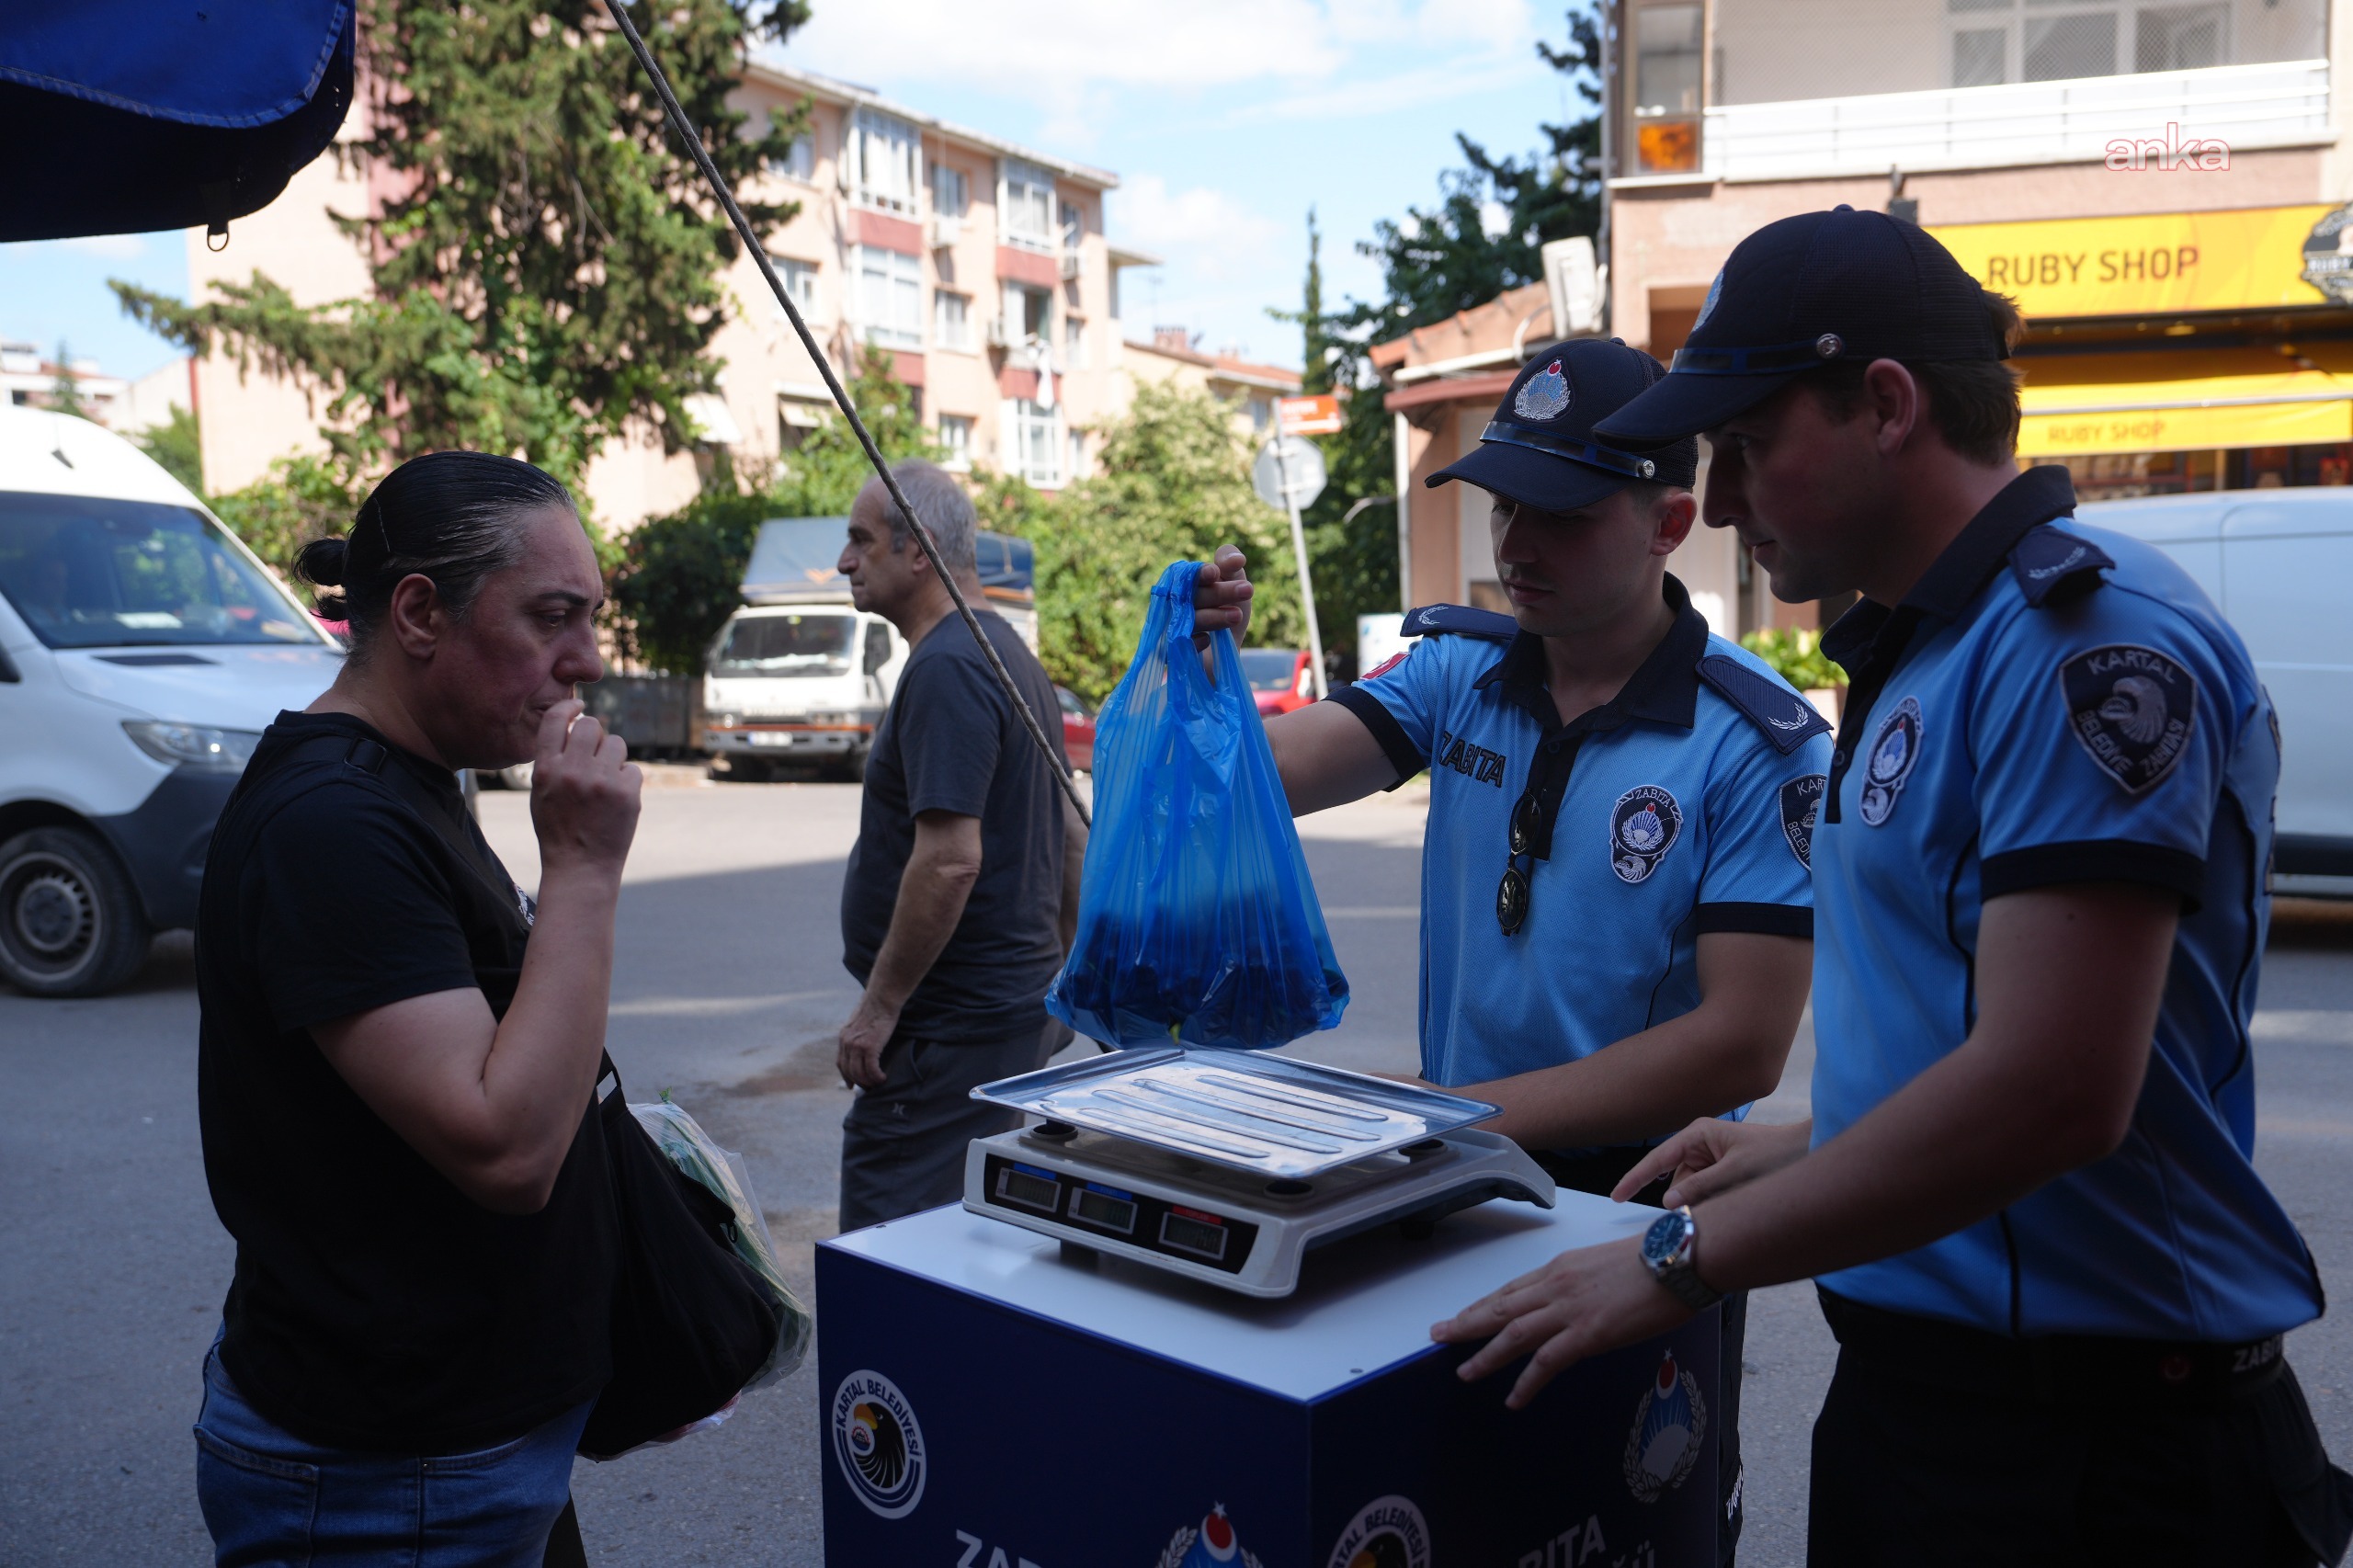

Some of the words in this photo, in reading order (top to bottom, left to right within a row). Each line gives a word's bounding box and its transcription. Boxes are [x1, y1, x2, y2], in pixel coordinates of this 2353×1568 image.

[1987, 253, 2087, 287] RUBY
[2097, 244, 2200, 283] SHOP
[2047, 424, 2103, 445] RUBY
[2109, 419, 2167, 442] SHOP
[2086, 649, 2177, 685] KARTAL
[1438, 730, 1507, 789] ZABITA
[1634, 788, 1672, 808] ZABITA
[835, 1379, 866, 1428] KARTAL
[867, 1378, 922, 1458] BELEDİYESİ
[1364, 1506, 1427, 1560] BELEDİYESİ
